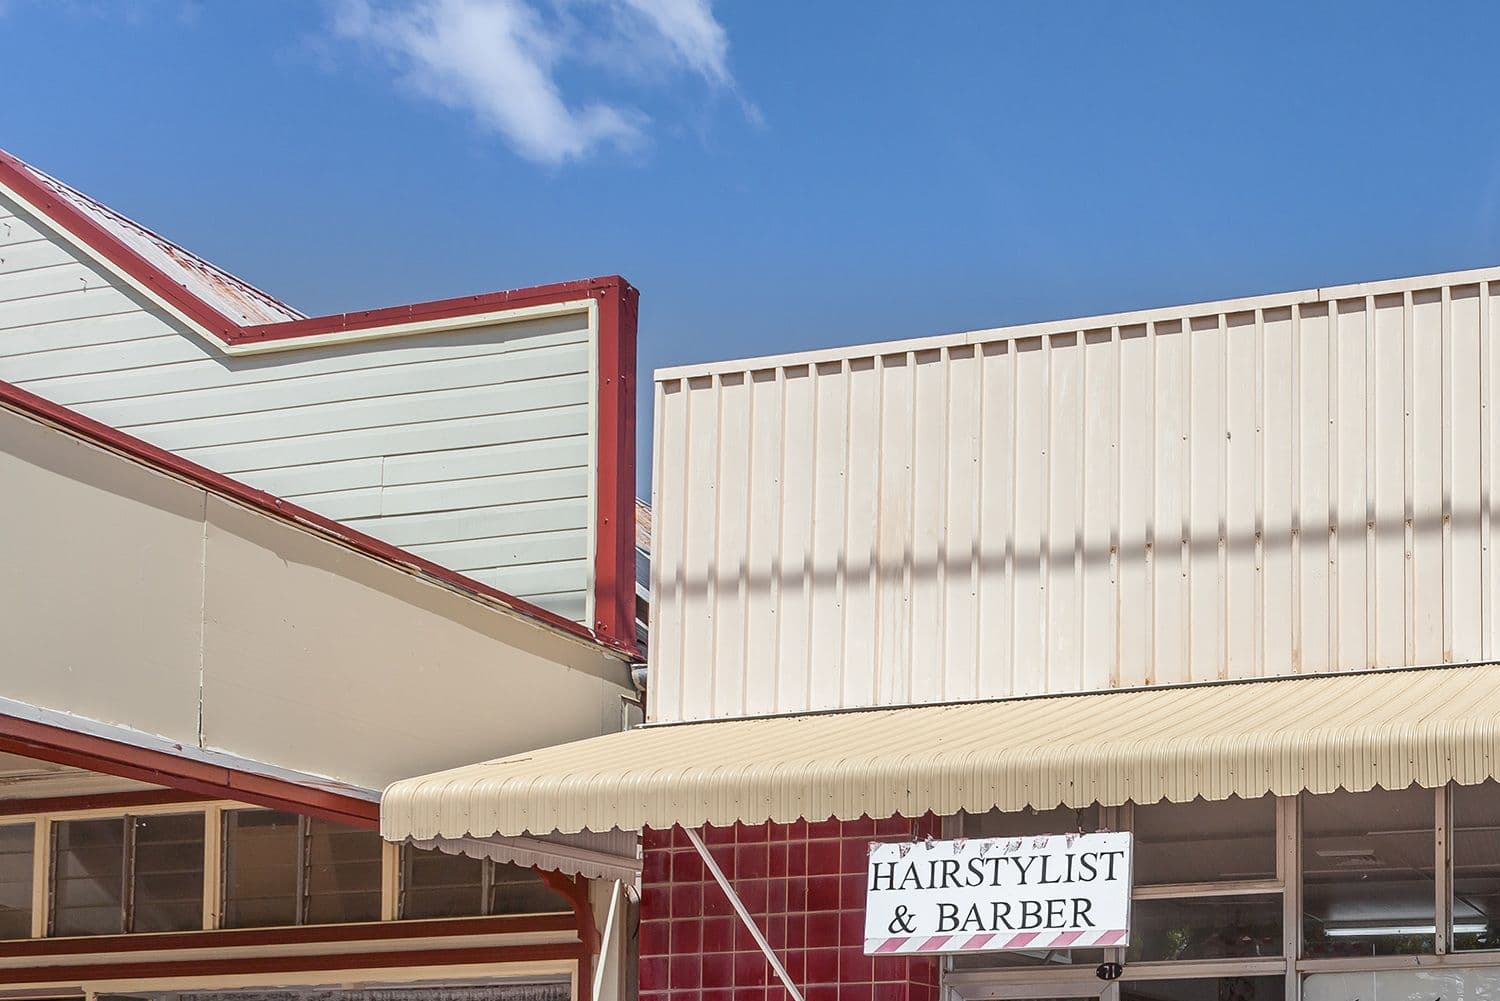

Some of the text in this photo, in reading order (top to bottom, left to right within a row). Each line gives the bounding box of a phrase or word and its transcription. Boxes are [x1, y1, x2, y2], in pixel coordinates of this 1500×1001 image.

[869, 850, 1124, 892] HAIRSTYLIST
[888, 898, 1096, 934] & BARBER
